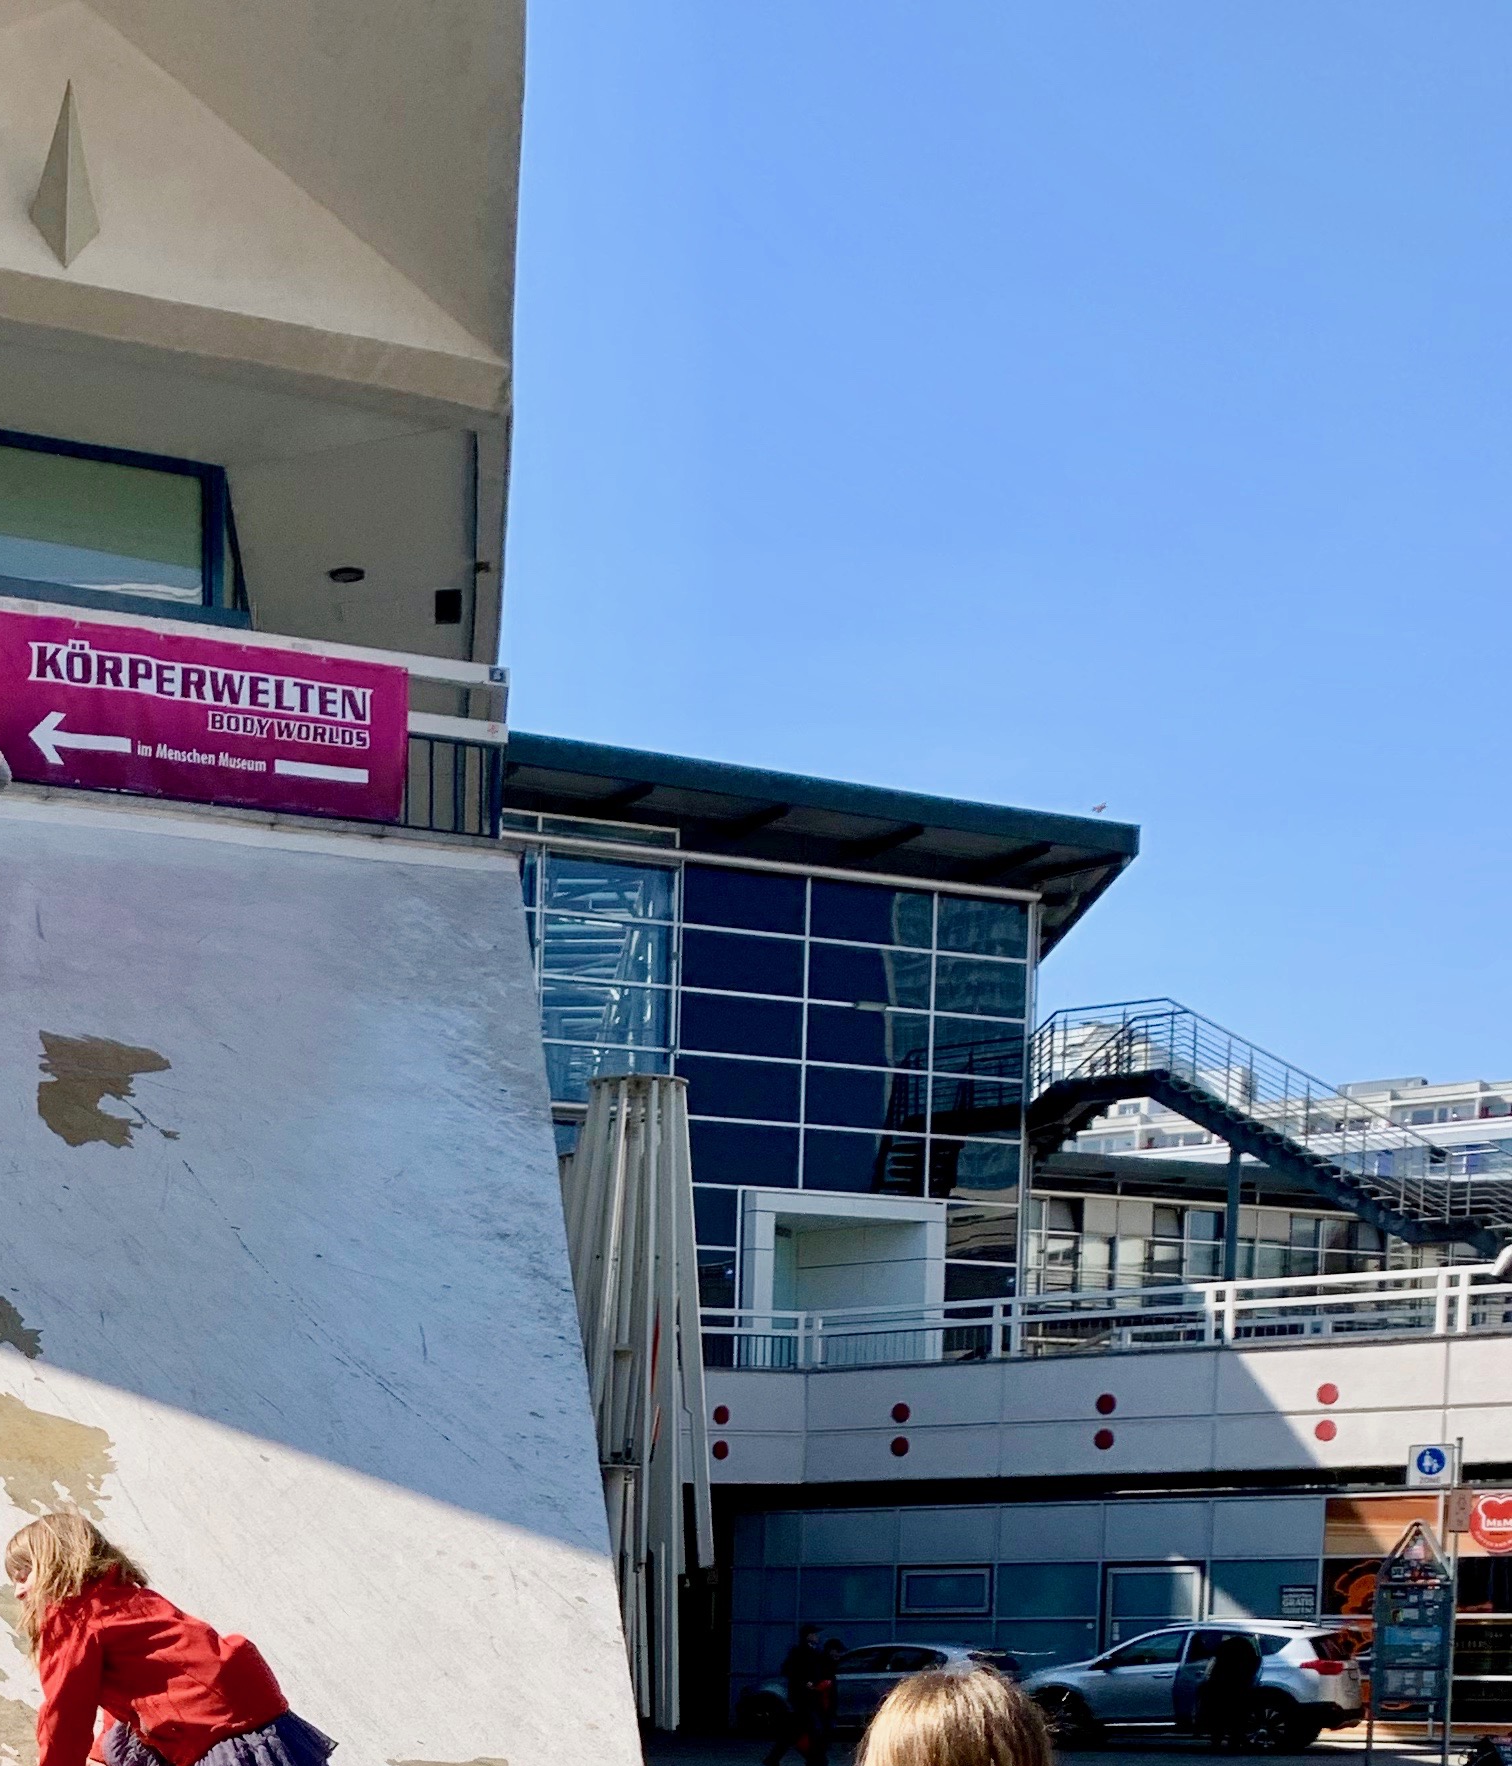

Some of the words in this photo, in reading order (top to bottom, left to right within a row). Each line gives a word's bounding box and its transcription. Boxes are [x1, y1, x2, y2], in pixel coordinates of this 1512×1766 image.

[33, 640, 369, 723] KÖRPERWELTEN
[209, 711, 271, 737] BODY
[274, 719, 369, 748] WORLDS
[137, 740, 152, 757] im
[155, 743, 216, 766] Menschen
[218, 751, 267, 772] Museum
